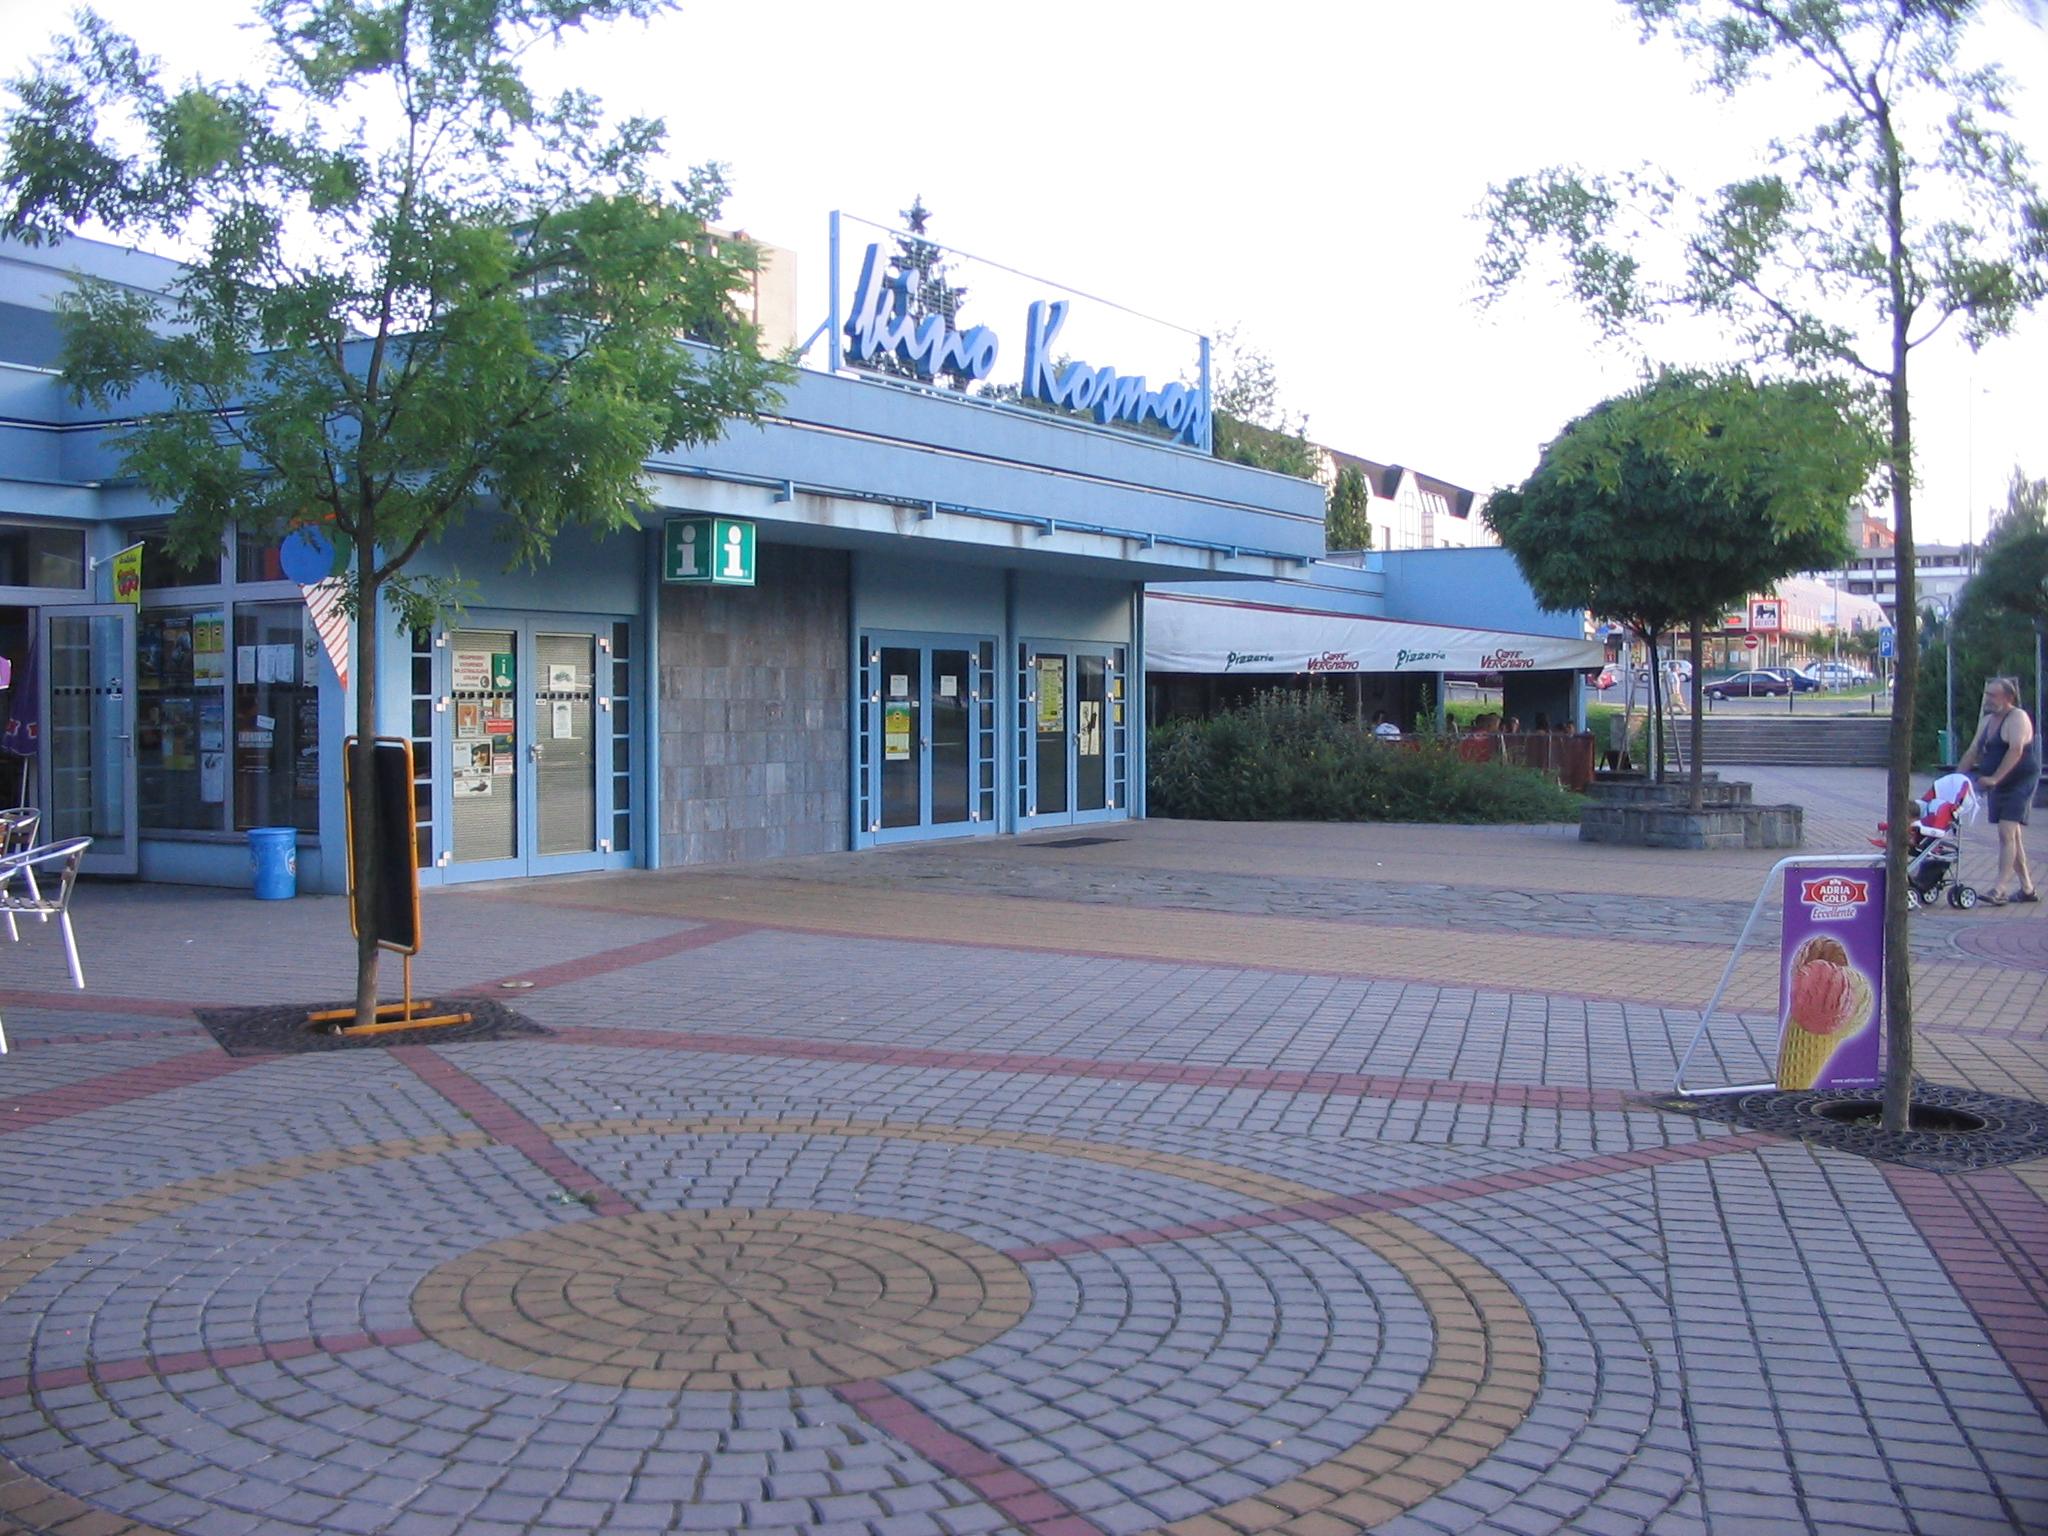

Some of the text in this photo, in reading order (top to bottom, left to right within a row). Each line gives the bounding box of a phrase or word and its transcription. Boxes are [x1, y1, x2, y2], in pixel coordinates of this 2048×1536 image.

[1881, 641, 1890, 652] P
[1225, 651, 1275, 672] Pizzeria
[1395, 649, 1447, 670] Pizzeria
[1819, 885, 1851, 895] ADRIA
[1822, 894, 1848, 903] GOLD
